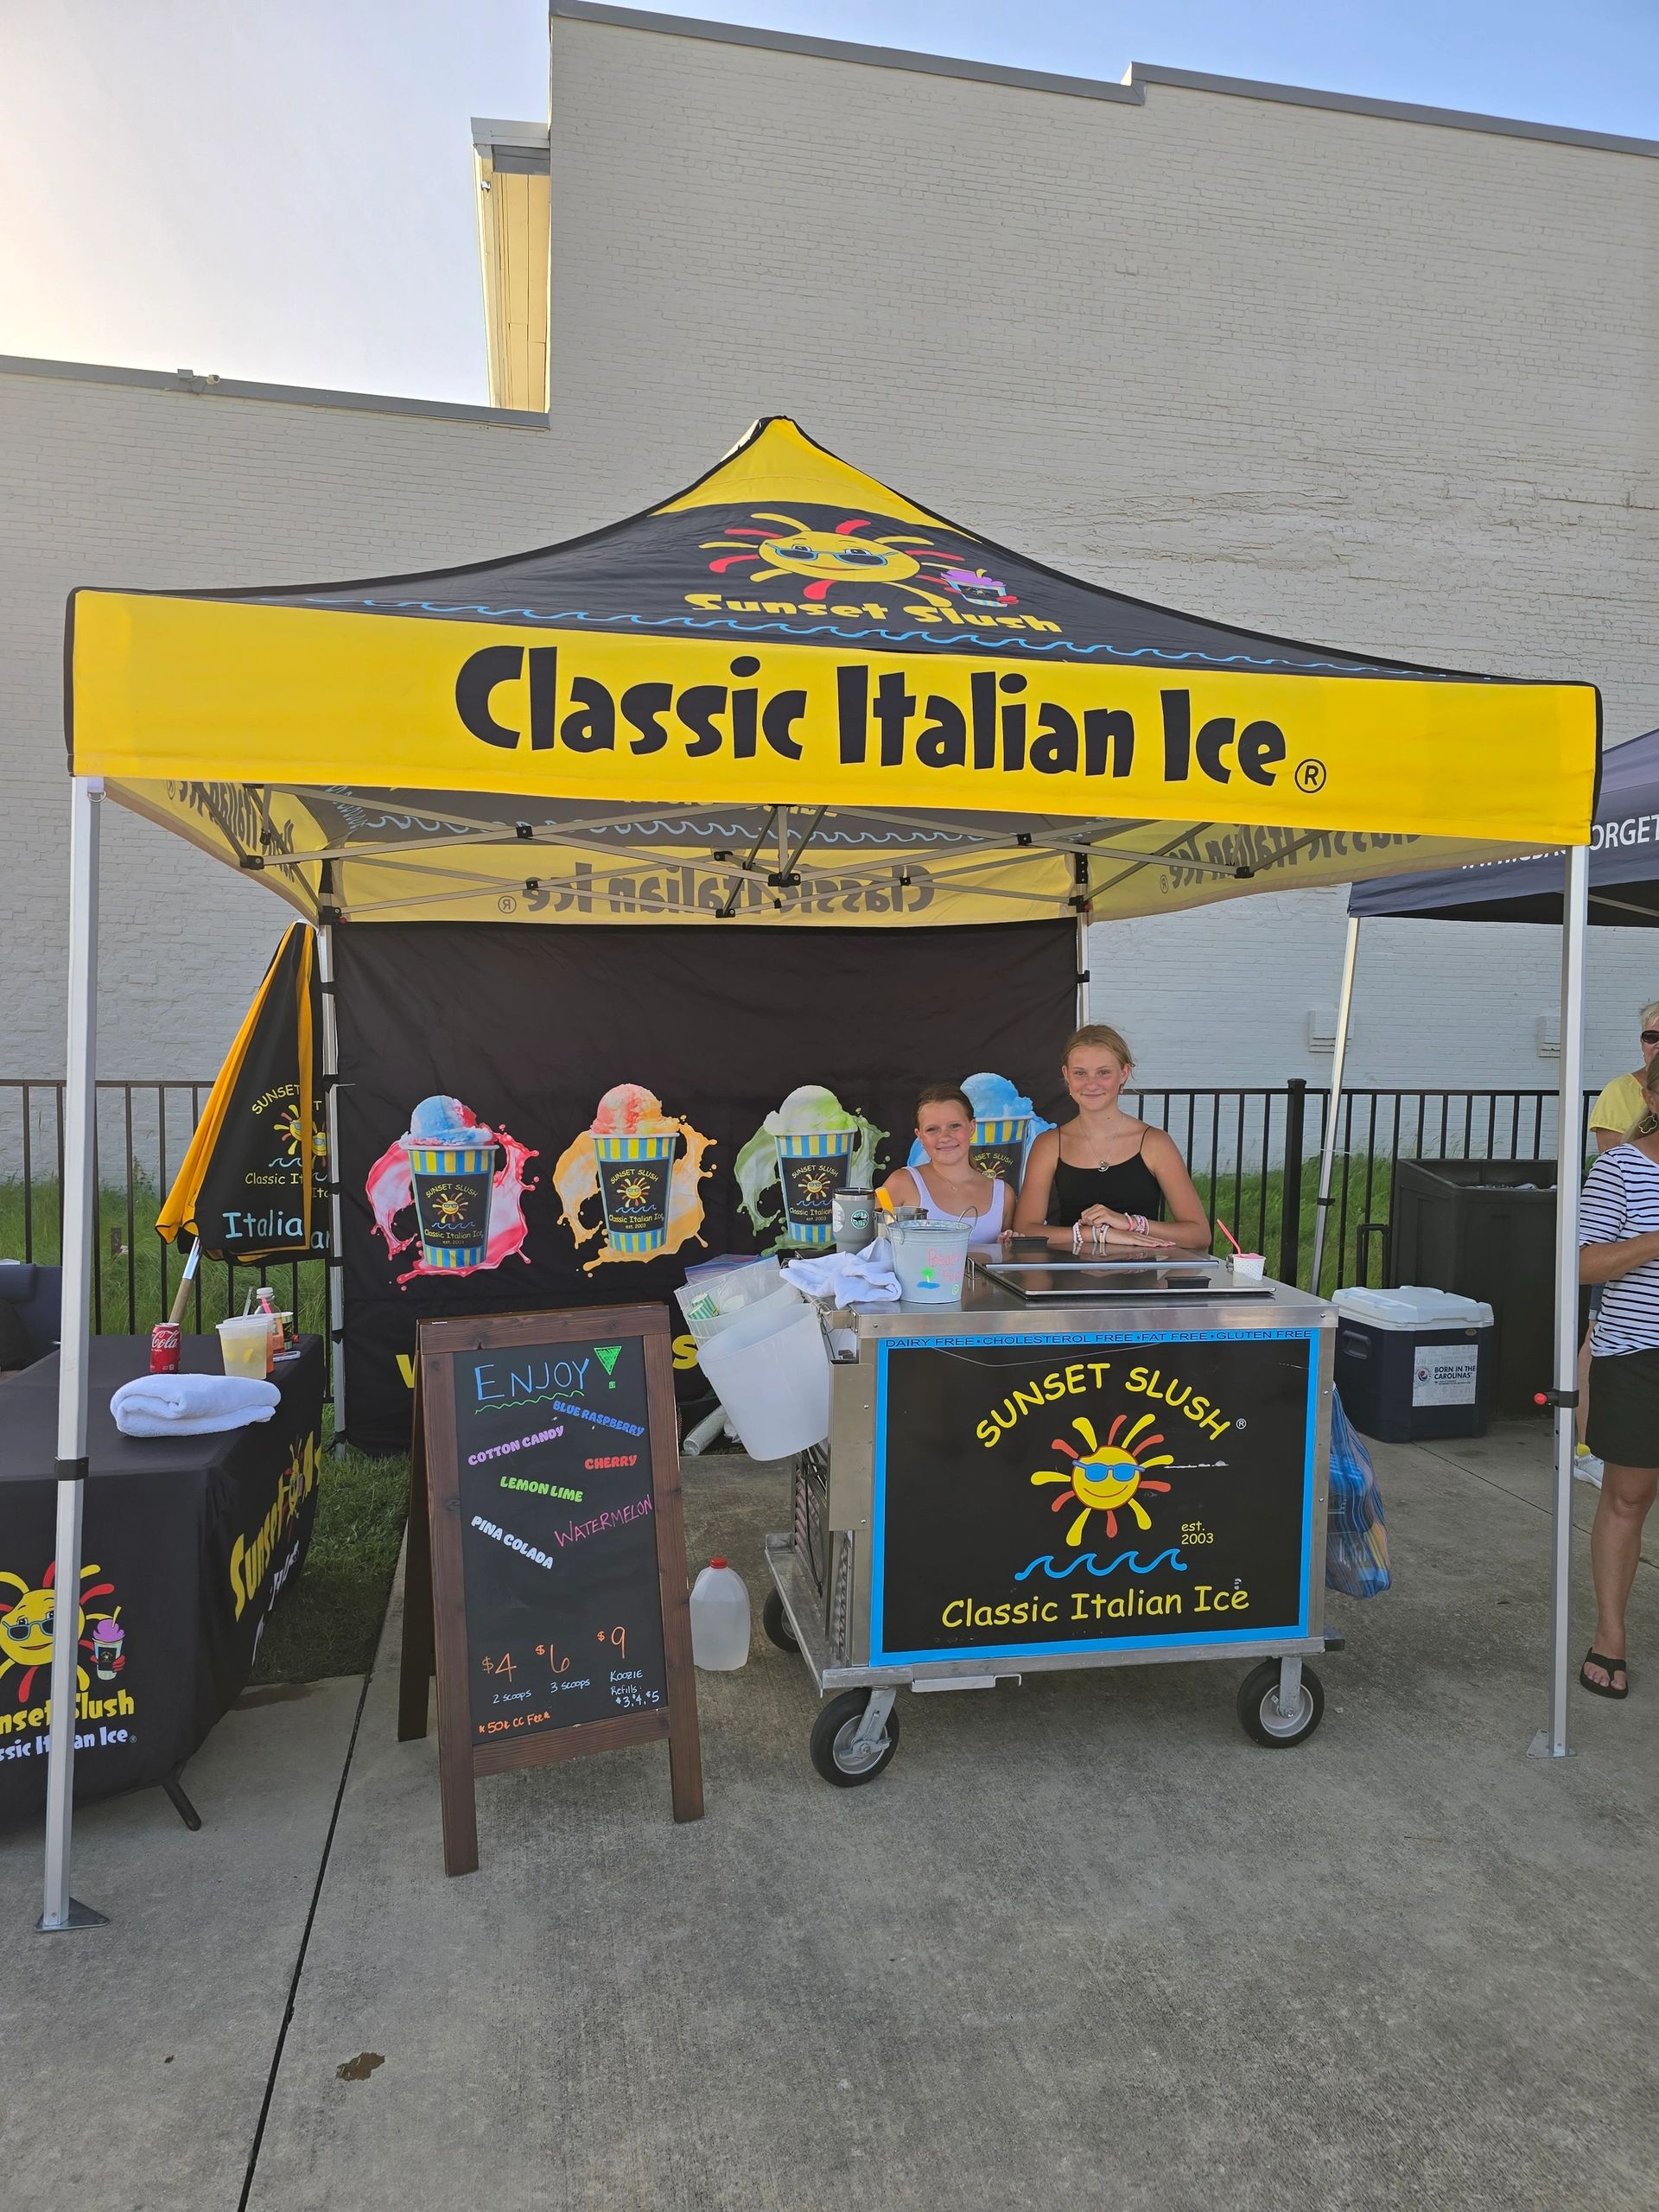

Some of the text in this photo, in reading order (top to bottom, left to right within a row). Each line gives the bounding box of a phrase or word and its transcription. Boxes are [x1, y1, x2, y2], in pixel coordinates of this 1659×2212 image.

[684, 594, 1063, 633] Sunset Slush
[454, 645, 808, 761] Classic
[836, 664, 1135, 779] Italian
[1160, 689, 1287, 787] Ice
[1589, 814, 1659, 851] ORGET
[251, 1084, 301, 1115] SUNSET
[791, 1165, 839, 1179] SUNSET SLUSH
[993, 1153, 1014, 1166] SLUSH
[245, 1173, 286, 1185] Classic
[425, 1184, 479, 1198] SUNSET SLUSH
[611, 1169, 659, 1185] SUNSET SLUSH
[222, 1210, 303, 1239] Italia
[424, 1229, 445, 1238] Classic
[608, 1214, 628, 1224] Classic
[885, 1338, 931, 1348] DAIRY
[935, 1338, 974, 1346] FREE
[982, 1334, 1090, 1345] CHOLESTEROL
[1096, 1333, 1133, 1342] FREE
[1171, 1332, 1208, 1341] FREE
[1216, 1331, 1272, 1340] GLUTEN
[1276, 1330, 1312, 1338] FREE
[552, 1400, 645, 1437] BLUE RASPBERRY
[976, 1363, 1111, 1448] SUNSET
[1124, 1366, 1231, 1440] SLUSH
[467, 1426, 565, 1466] COTTON CANDY
[584, 1454, 638, 1471] CHERRY
[499, 1476, 584, 1503] LEMON LIME
[554, 1494, 653, 1548] WATERMELON
[1181, 1522, 1205, 1533] est.
[471, 1515, 554, 1569] PINA COLADA
[1181, 1532, 1214, 1545] 2003
[942, 1585, 1249, 1628] Classic Italian Ice
[596, 1626, 626, 1659] $9
[481, 1652, 518, 1683] $4
[535, 1643, 570, 1674] $6
[493, 1693, 500, 1704] 2
[550, 1681, 558, 1694] 3
[0, 1699, 52, 1735] nset
[0, 1738, 31, 1763] ssic
[99, 1726, 129, 1746] Ice
